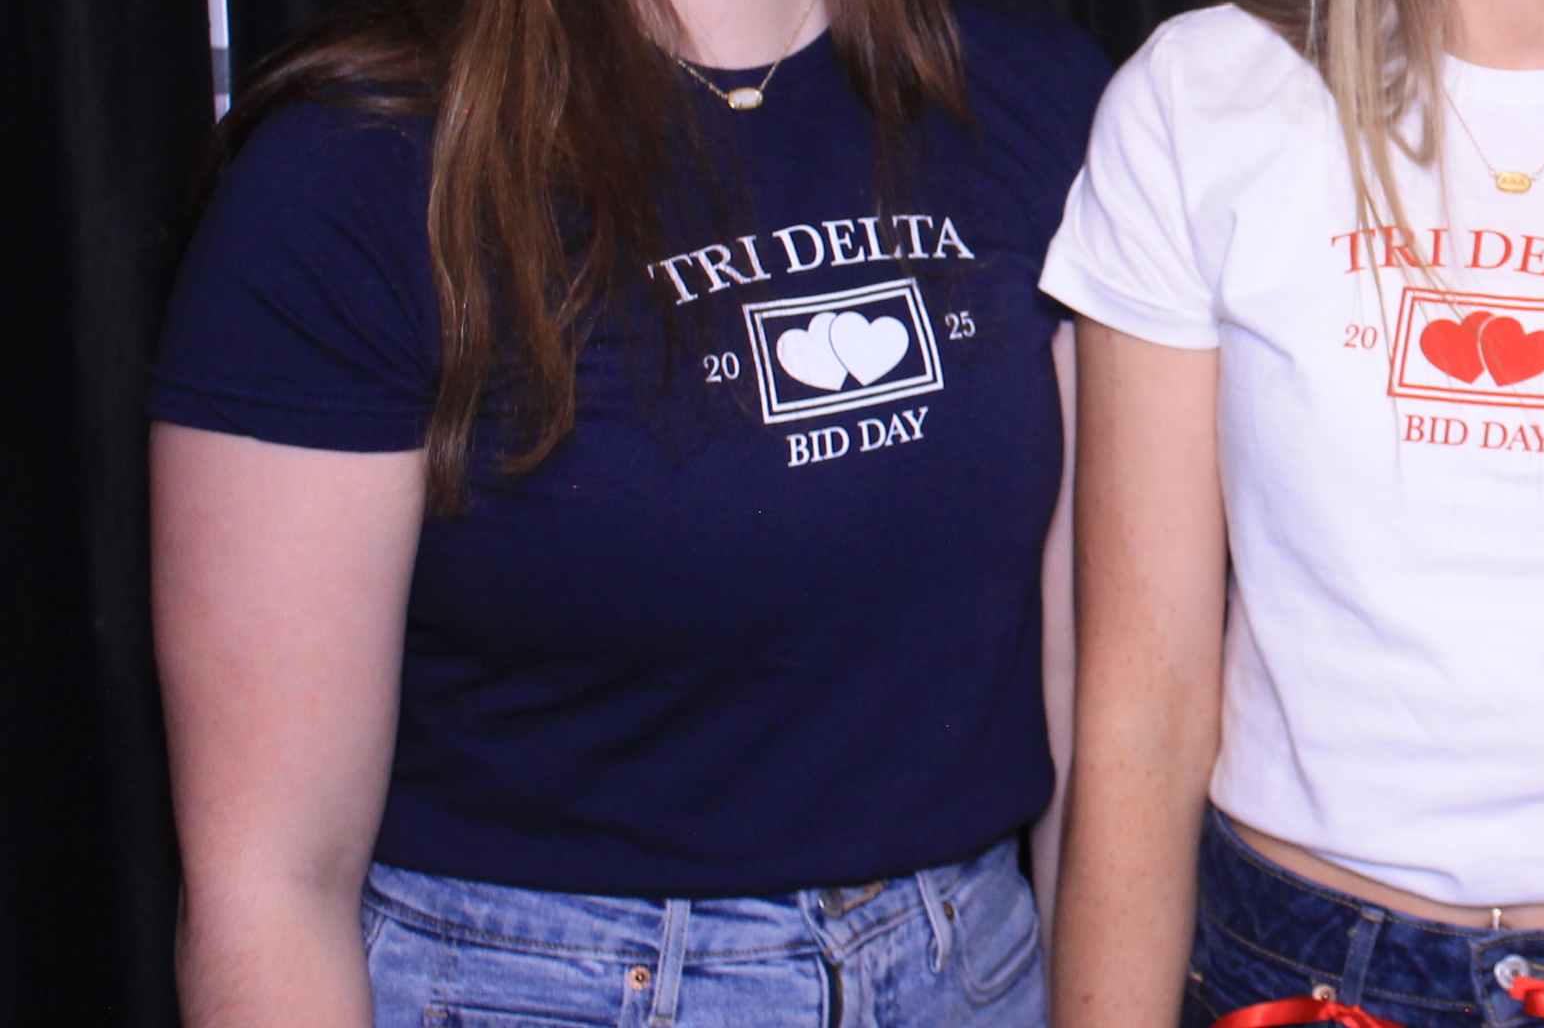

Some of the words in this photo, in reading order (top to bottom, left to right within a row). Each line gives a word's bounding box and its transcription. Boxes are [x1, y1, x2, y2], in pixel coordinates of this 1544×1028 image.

[647, 235, 772, 306] TRI
[772, 214, 976, 274] DELTA
[1331, 224, 1449, 274] TRI
[703, 351, 741, 384] 20
[944, 310, 977, 341] 25
[1343, 324, 1378, 350] 20
[786, 425, 850, 468] BID
[857, 406, 930, 452] DAY
[1402, 414, 1469, 446] BID
